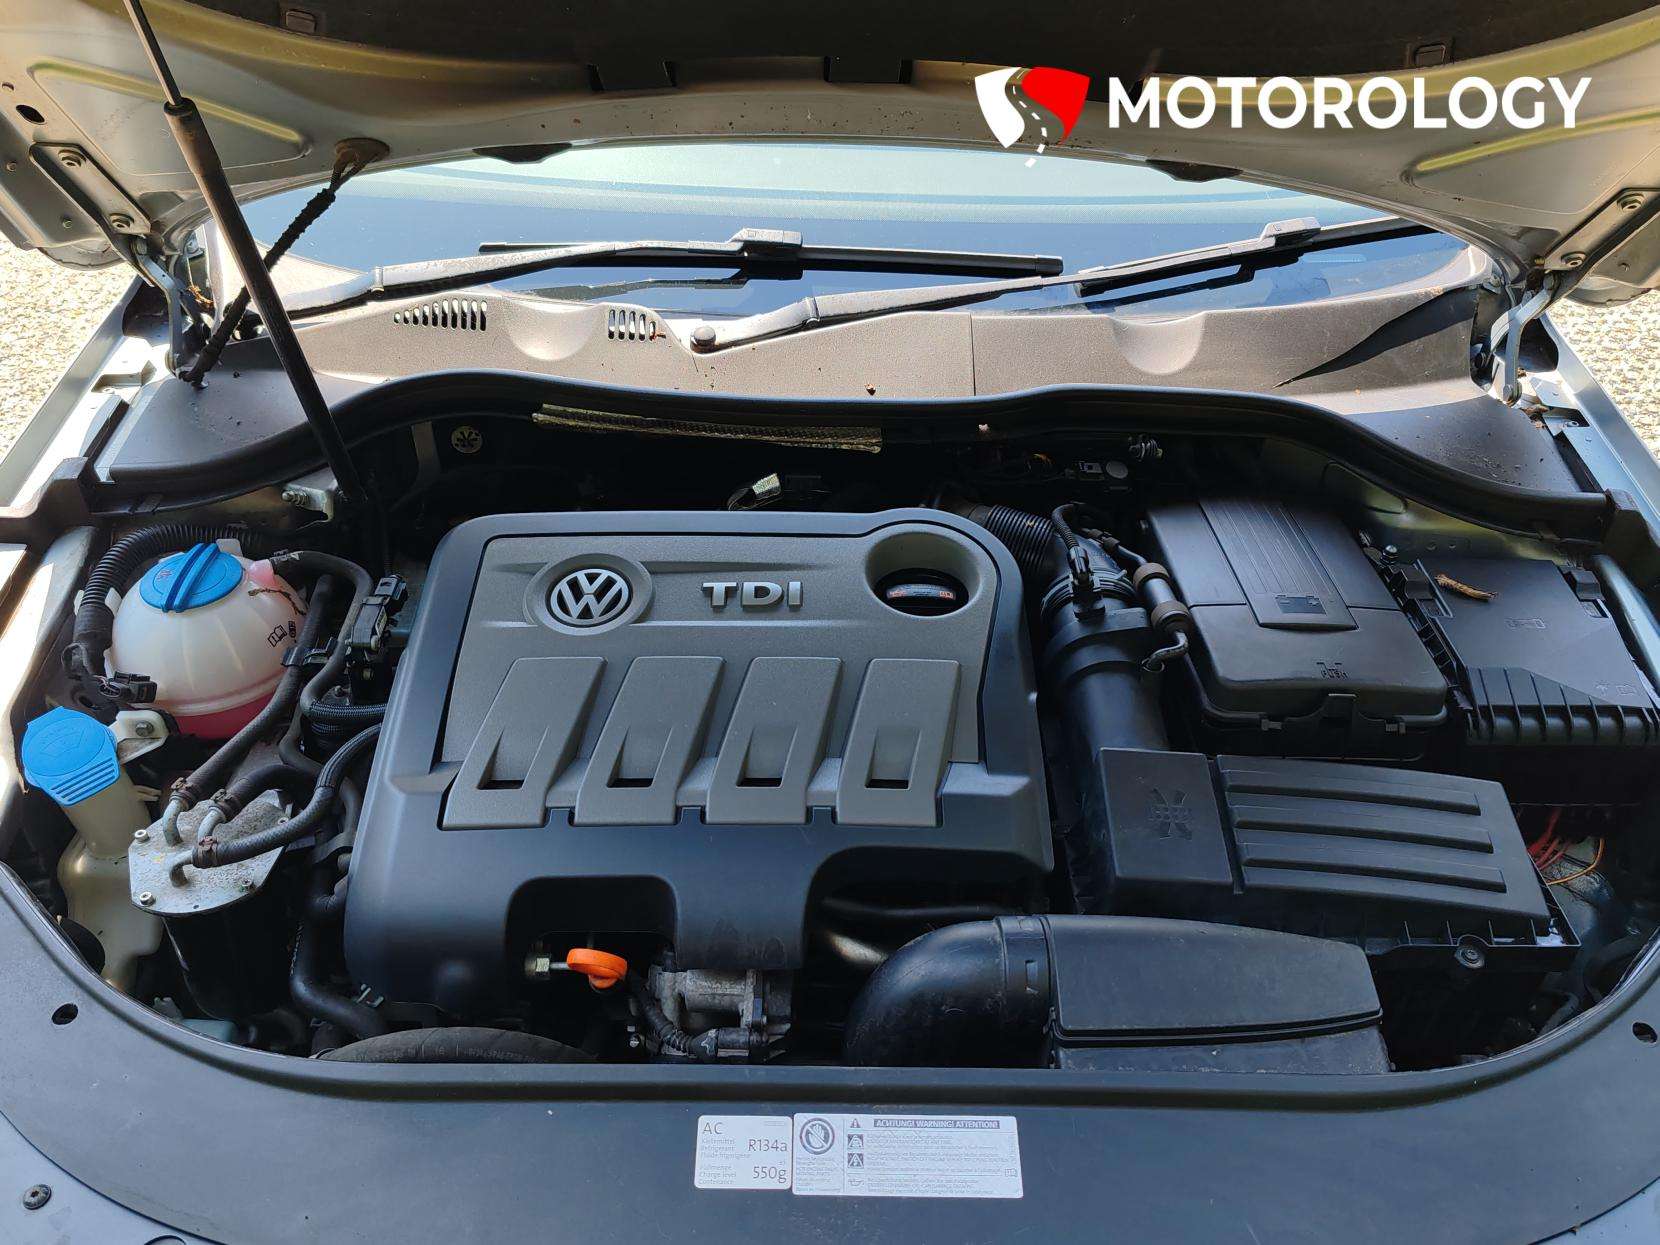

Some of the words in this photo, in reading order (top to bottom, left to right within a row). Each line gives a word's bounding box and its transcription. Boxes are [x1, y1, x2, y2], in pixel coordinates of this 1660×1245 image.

[702, 581, 803, 607] TDI
[702, 1122, 723, 1135] AC
[876, 1119, 914, 1127] ACHTUNG!
[915, 1120, 954, 1128] WARNING!
[955, 1121, 998, 1129] ATTENTION!
[748, 1138, 787, 1152] R134a
[753, 1166, 787, 1184] 550g
